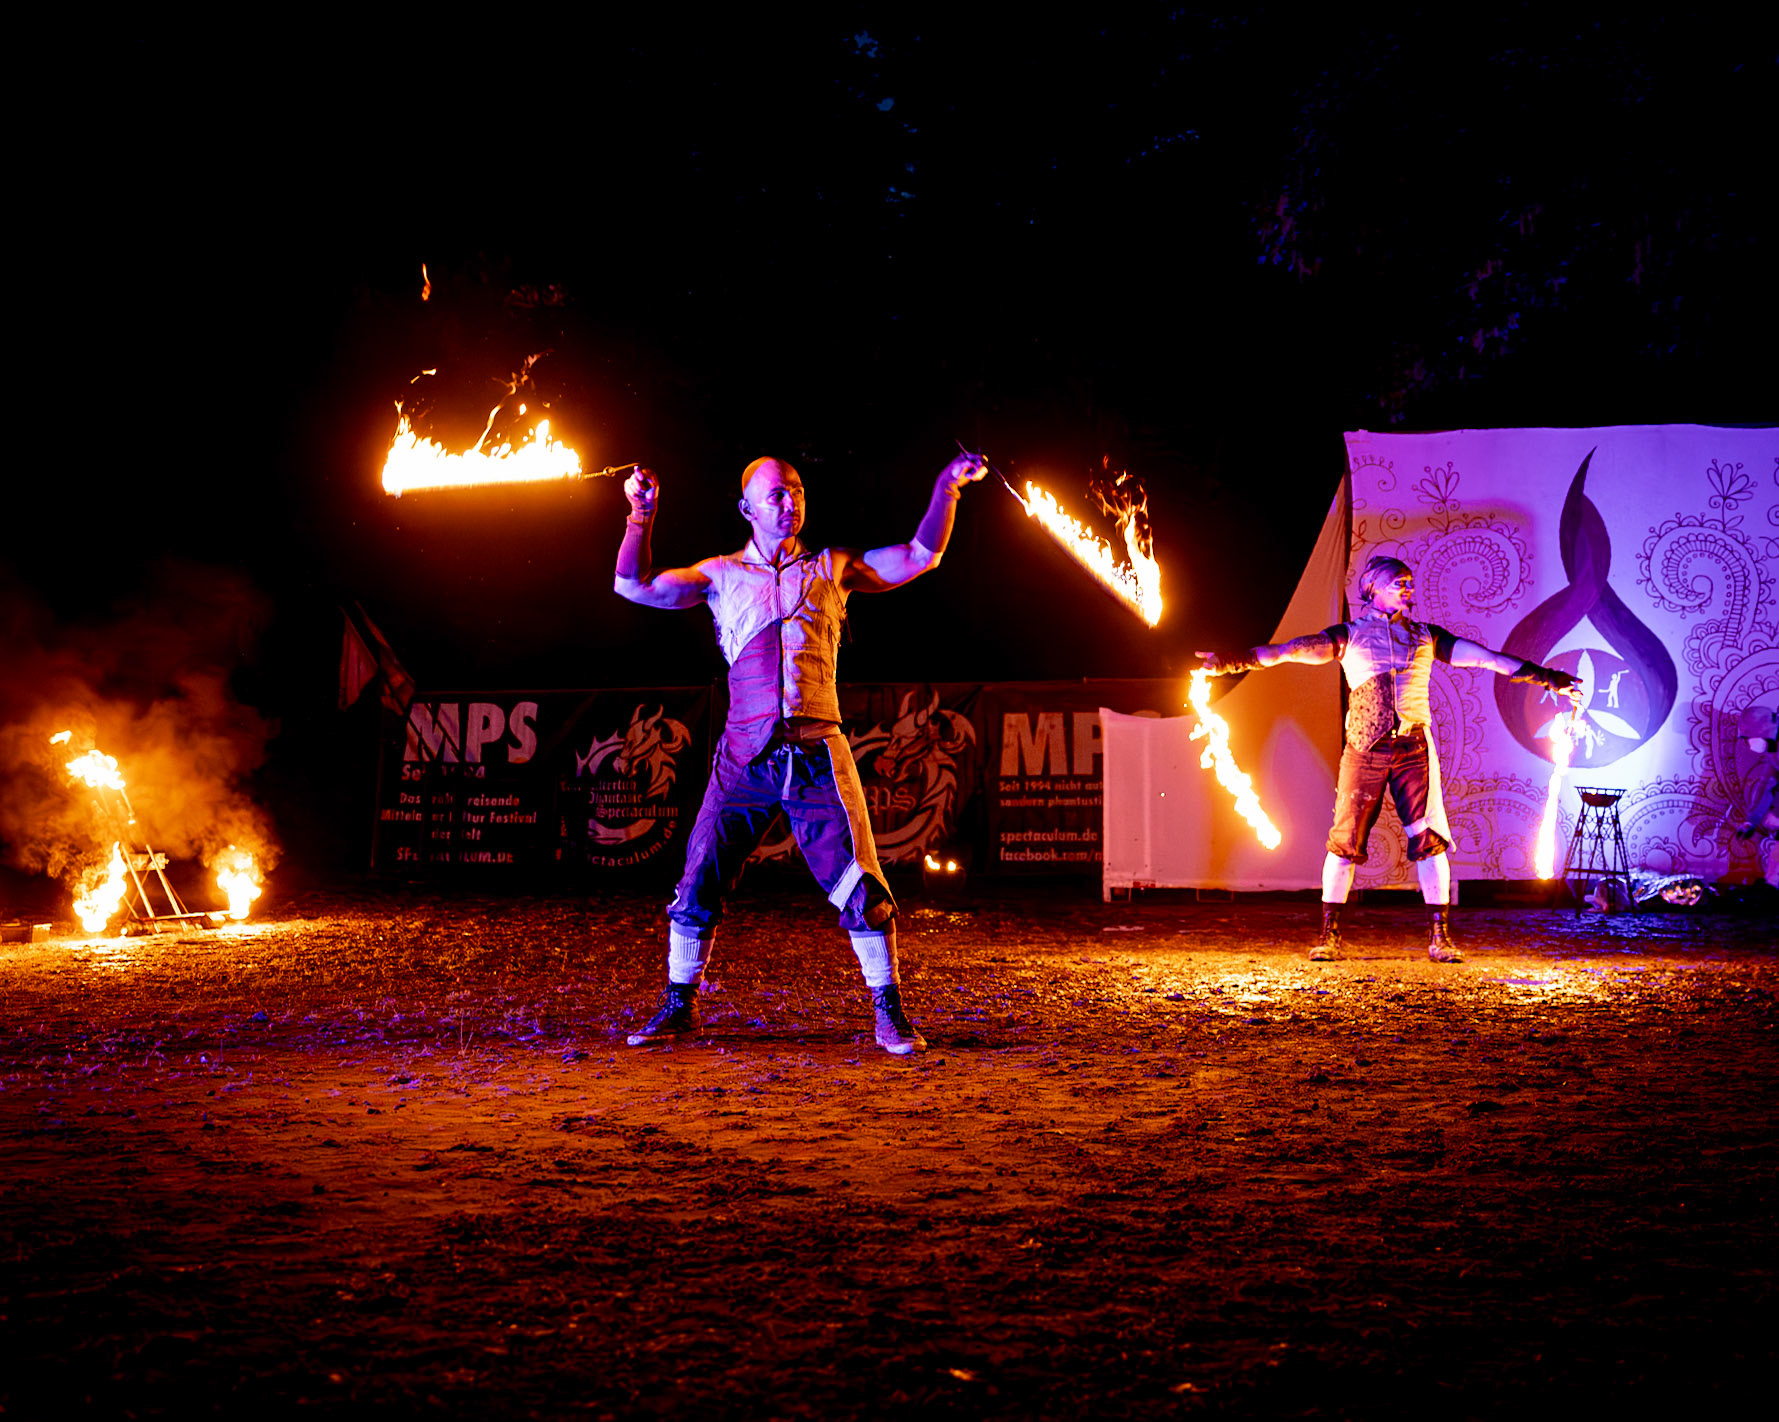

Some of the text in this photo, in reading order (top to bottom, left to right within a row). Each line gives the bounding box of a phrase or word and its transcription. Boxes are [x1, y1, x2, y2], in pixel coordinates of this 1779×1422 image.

[402, 701, 538, 764] MPS
[1000, 710, 1161, 776] MP
[999, 780, 1020, 792] Seit
[1025, 780, 1051, 792] 1994
[1054, 779, 1081, 791] nicht
[399, 791, 422, 805] Das
[467, 793, 520, 807] reisende
[1000, 794, 1045, 807] sondern
[379, 807, 444, 823] Mittelaer
[488, 809, 538, 824] Festival
[595, 803, 678, 821] Spectaculum
[1000, 827, 1098, 845] spectaculum.de
